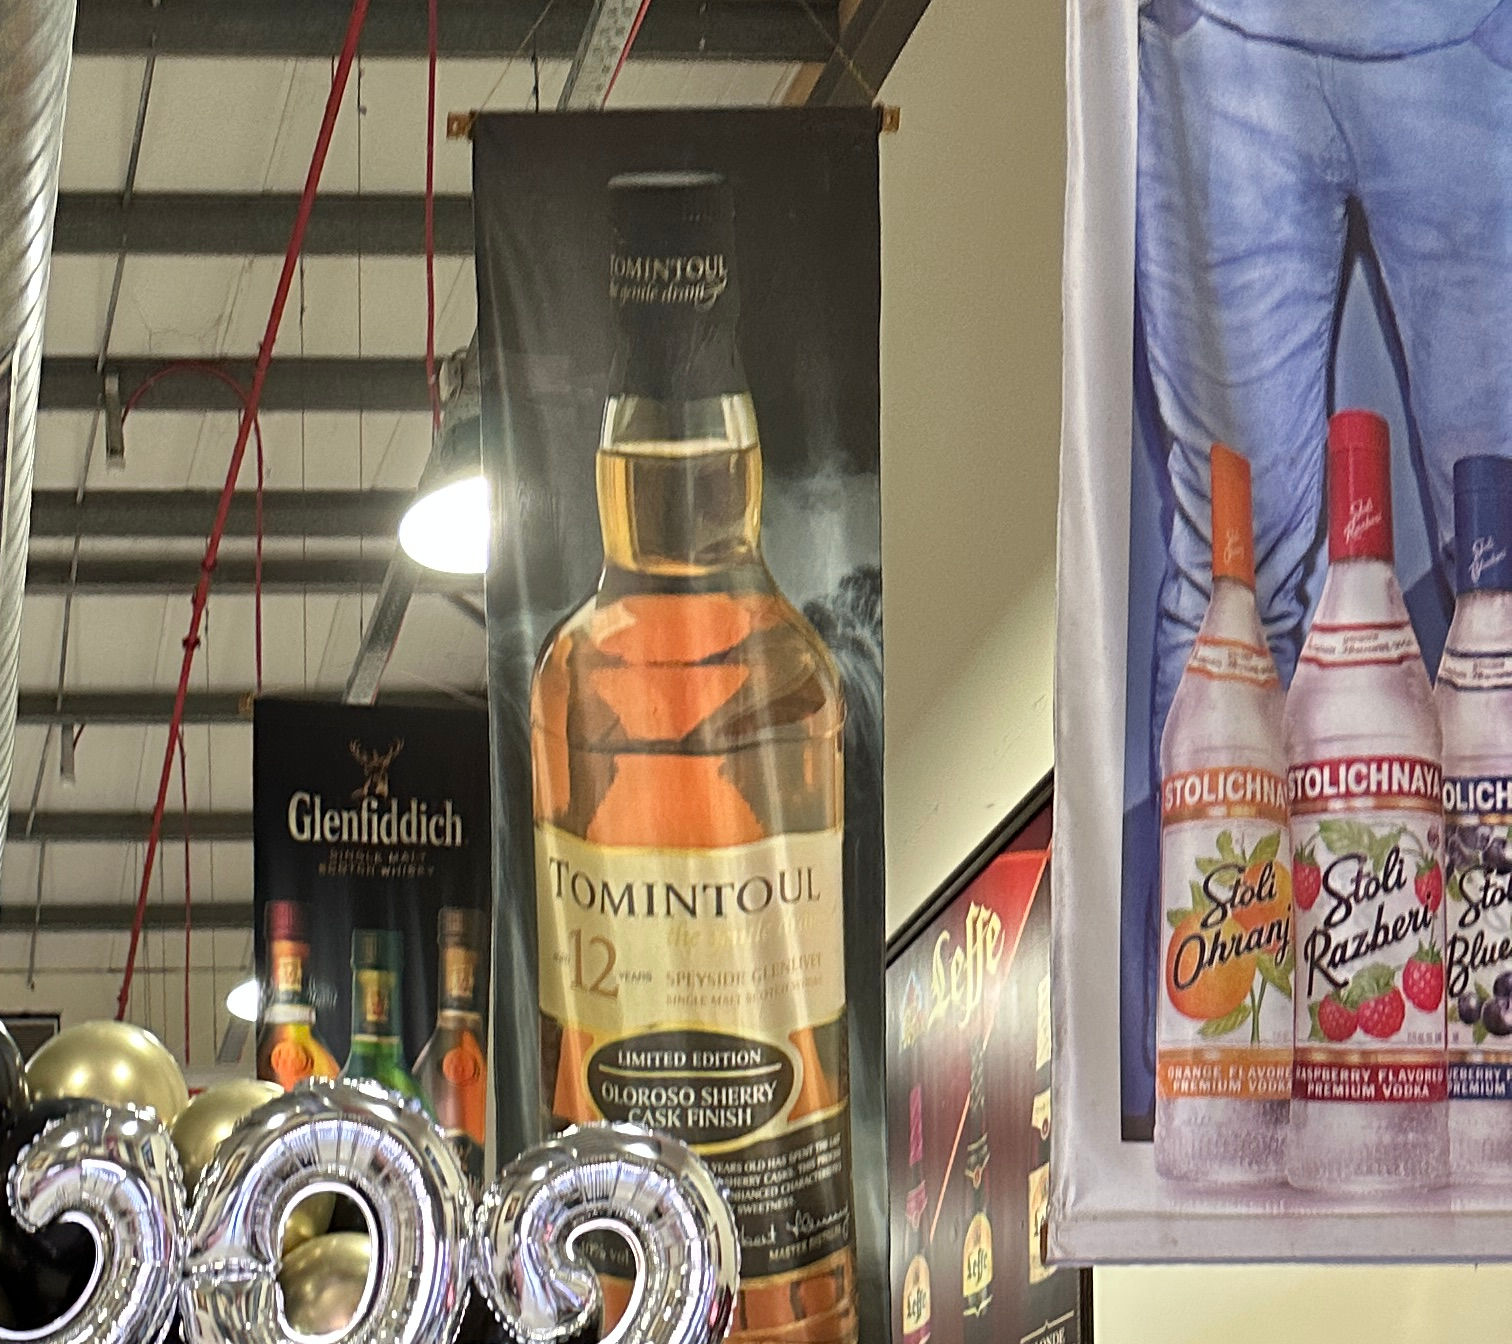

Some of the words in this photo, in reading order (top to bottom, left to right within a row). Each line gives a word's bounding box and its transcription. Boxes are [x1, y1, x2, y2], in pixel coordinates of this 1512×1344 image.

[288, 790, 464, 849] Glenfiddich
[549, 856, 822, 919] TOMINTOUL
[1200, 861, 1278, 930] Stoli
[1323, 846, 1407, 929] Stoli
[568, 928, 620, 1000] 12
[926, 900, 1006, 1031] Leffe
[1173, 903, 1291, 992] Ohranj
[1303, 893, 1433, 999] Razberi
[617, 1048, 687, 1068] LIMITED
[692, 1047, 762, 1067] EDITION
[1307, 1082, 1376, 1098] PREMIUM
[1382, 1082, 1430, 1098] VODKA
[601, 1080, 696, 1107] OLOROSO
[701, 1080, 777, 1103] SHERRY
[629, 1107, 682, 1129] CASK
[687, 1106, 753, 1128] FINISH
